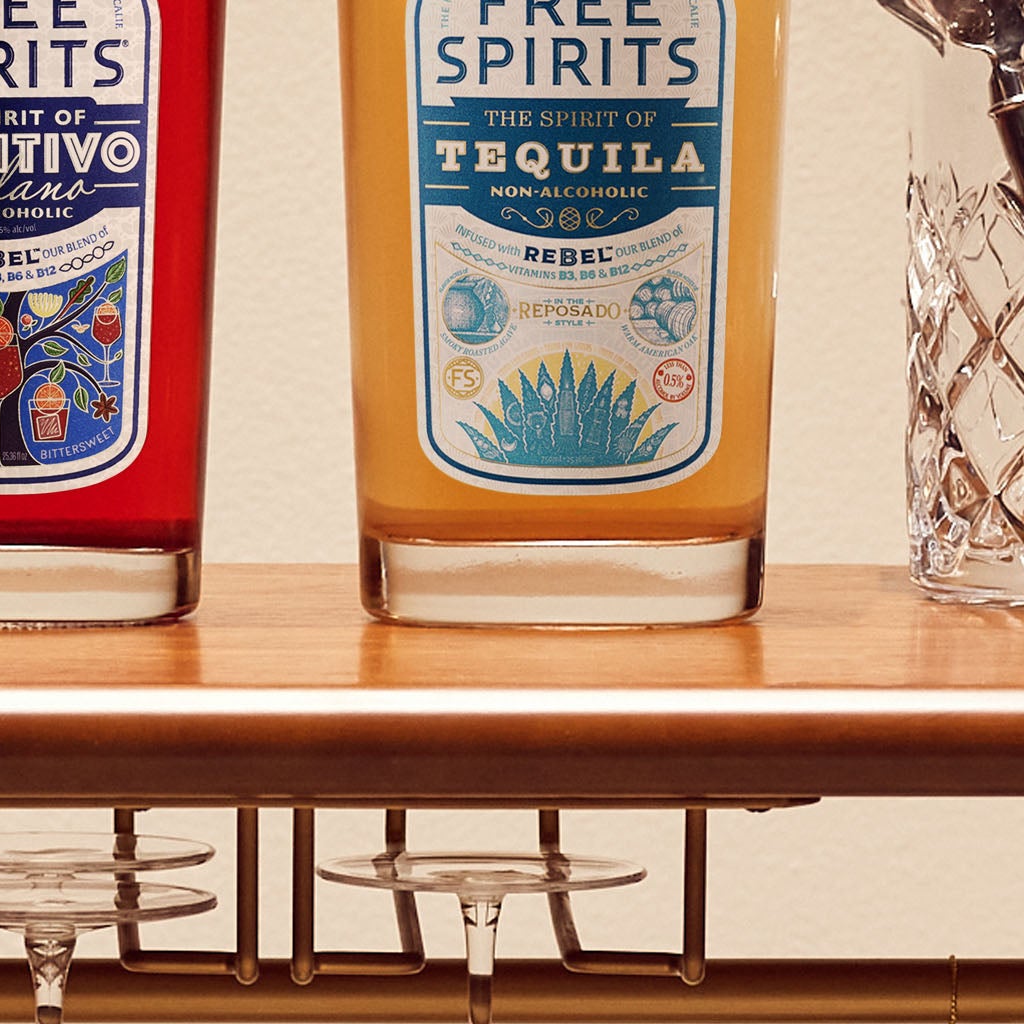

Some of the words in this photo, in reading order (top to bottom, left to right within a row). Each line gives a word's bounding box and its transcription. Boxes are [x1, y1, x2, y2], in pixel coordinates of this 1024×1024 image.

[441, 7, 450, 29] THE
[436, 36, 699, 87] SPIRITS
[55, 109, 86, 126] OF
[484, 110, 532, 127] THE
[539, 110, 619, 128] SPIRIT
[625, 110, 657, 128] OF
[435, 139, 705, 181] TEQUILA
[490, 185, 649, 198] NON-ALCOHOLIC
[12, 223, 37, 234] alc/vol
[42, 246, 64, 259] OUR
[66, 235, 97, 254] BLEND
[98, 226, 109, 240] of
[456, 224, 496, 250] INFUSED
[498, 244, 521, 257] with
[615, 244, 638, 258] OUR
[640, 232, 672, 252] BLEND
[673, 224, 684, 237] of
[7, 272, 23, 282] B6
[25, 270, 33, 279] &
[37, 265, 56, 277] B12
[509, 264, 556, 280] VITAMINS
[558, 271, 577, 281] B3,
[579, 270, 596, 280] B6
[598, 268, 607, 278] &
[609, 264, 631, 276] B12
[519, 301, 621, 320] REPOSADO
[440, 332, 463, 353] SMOKY
[463, 343, 499, 357] ROASTED
[499, 323, 517, 348] AGAVE
[621, 323, 640, 349] WARM
[639, 343, 684, 357] AMERICAN
[684, 334, 698, 349] OAK
[451, 369, 476, 388] FS
[664, 373, 684, 388] 0.5%
[40, 426, 115, 460] BITTERSWEET
